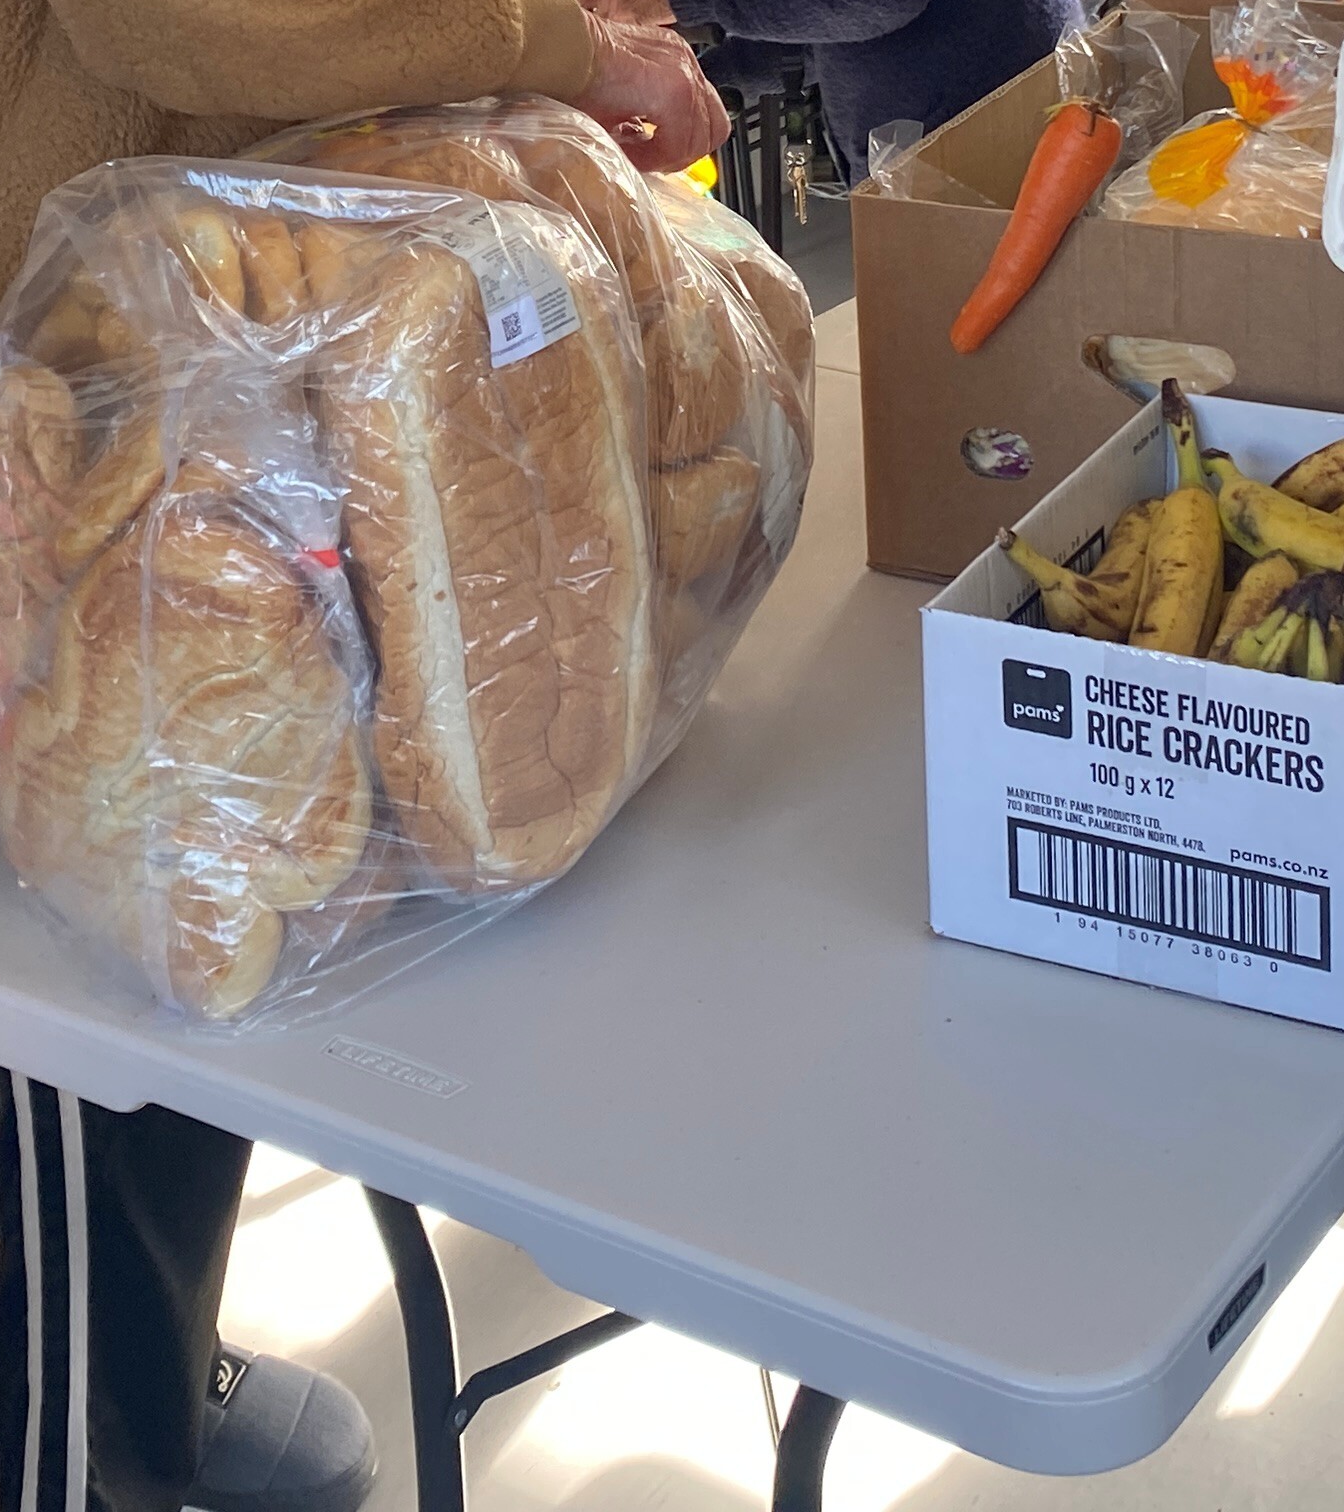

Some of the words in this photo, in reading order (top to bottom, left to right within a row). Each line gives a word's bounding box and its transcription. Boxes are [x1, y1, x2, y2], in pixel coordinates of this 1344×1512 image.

[1012, 701, 1061, 723] pams
[1085, 674, 1170, 718] CHEESE
[1177, 694, 1310, 746] FLAVOURED
[1087, 709, 1153, 758] RICE
[1163, 726, 1325, 794] CRACKERS
[1089, 762, 1119, 787] 100
[1125, 775, 1135, 796] g
[1140, 779, 1151, 795] x
[1155, 777, 1175, 800] 12
[1006, 786, 1052, 805] MARKETED
[1069, 800, 1094, 815] PAMS
[1096, 805, 1141, 825] PRODUCTS
[1006, 799, 1022, 811] 703
[1024, 802, 1063, 821] ROBERTS
[1088, 816, 1145, 838] PALMERSTON
[1230, 848, 1329, 879] pams.co.nz
[1054, 912, 1061, 923] 1
[1078, 917, 1099, 931] 94
[1117, 926, 1175, 949] 15077
[1191, 943, 1252, 967] 38063
[1270, 961, 1278, 973] 0
